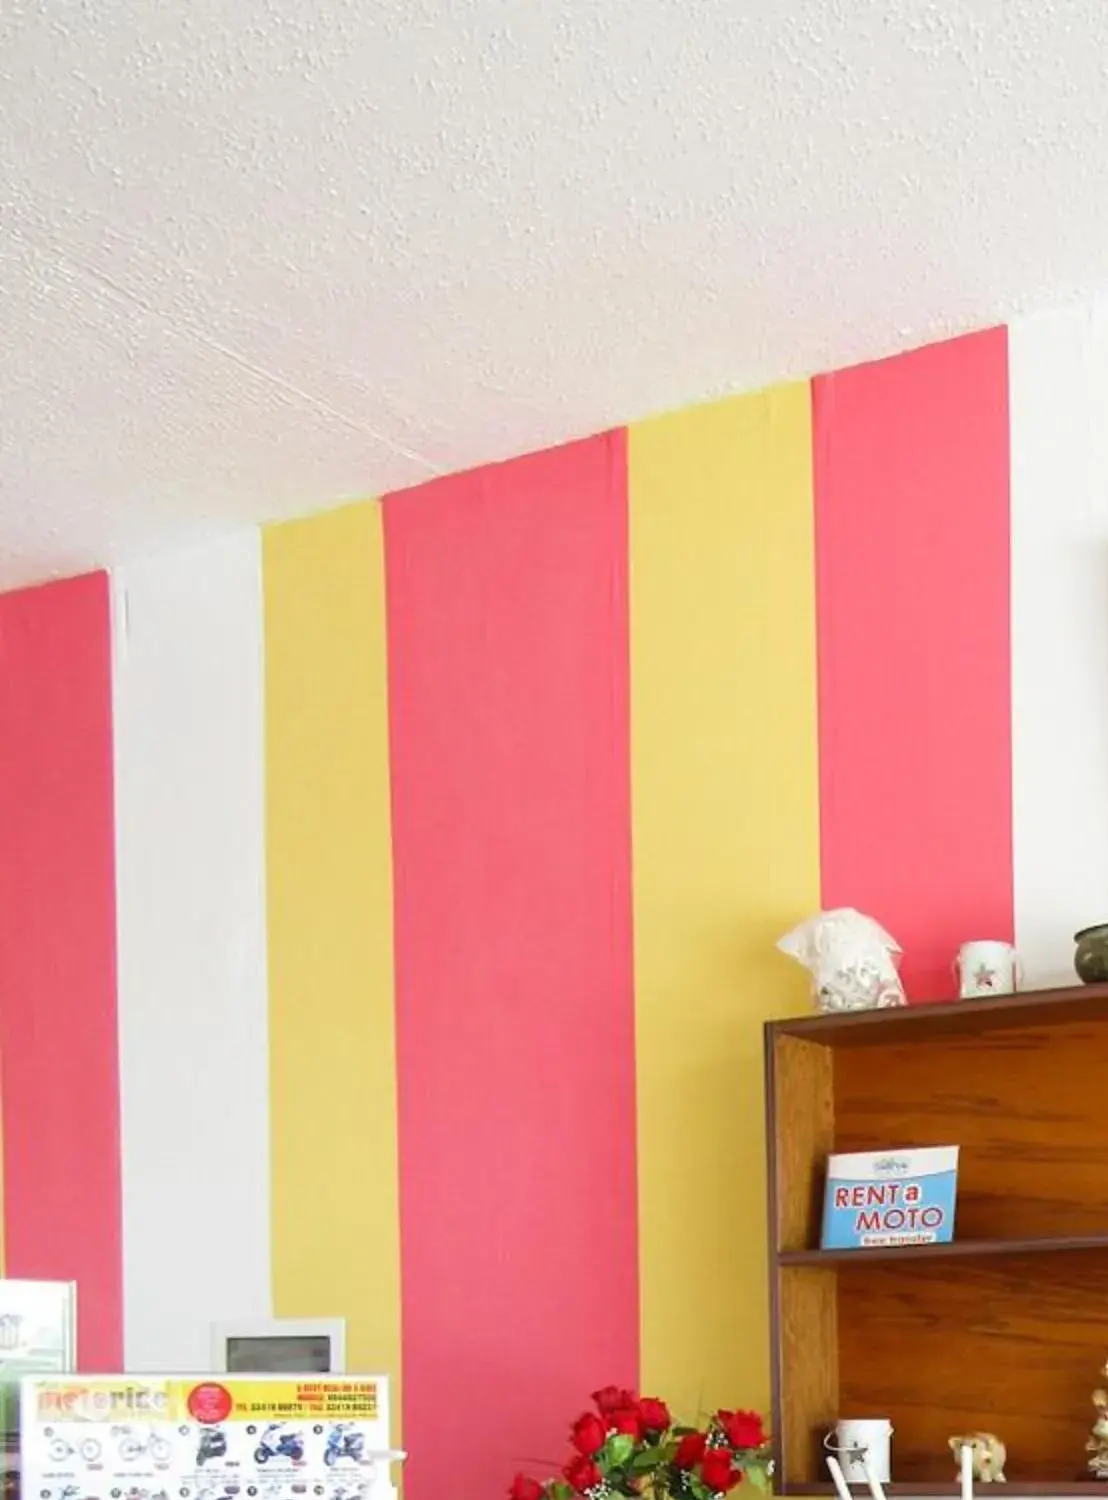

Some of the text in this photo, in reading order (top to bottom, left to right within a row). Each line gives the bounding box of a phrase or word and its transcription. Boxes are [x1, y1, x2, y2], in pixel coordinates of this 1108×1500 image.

[835, 1183, 920, 1208] RENT a
[855, 1206, 943, 1232] MOTO
